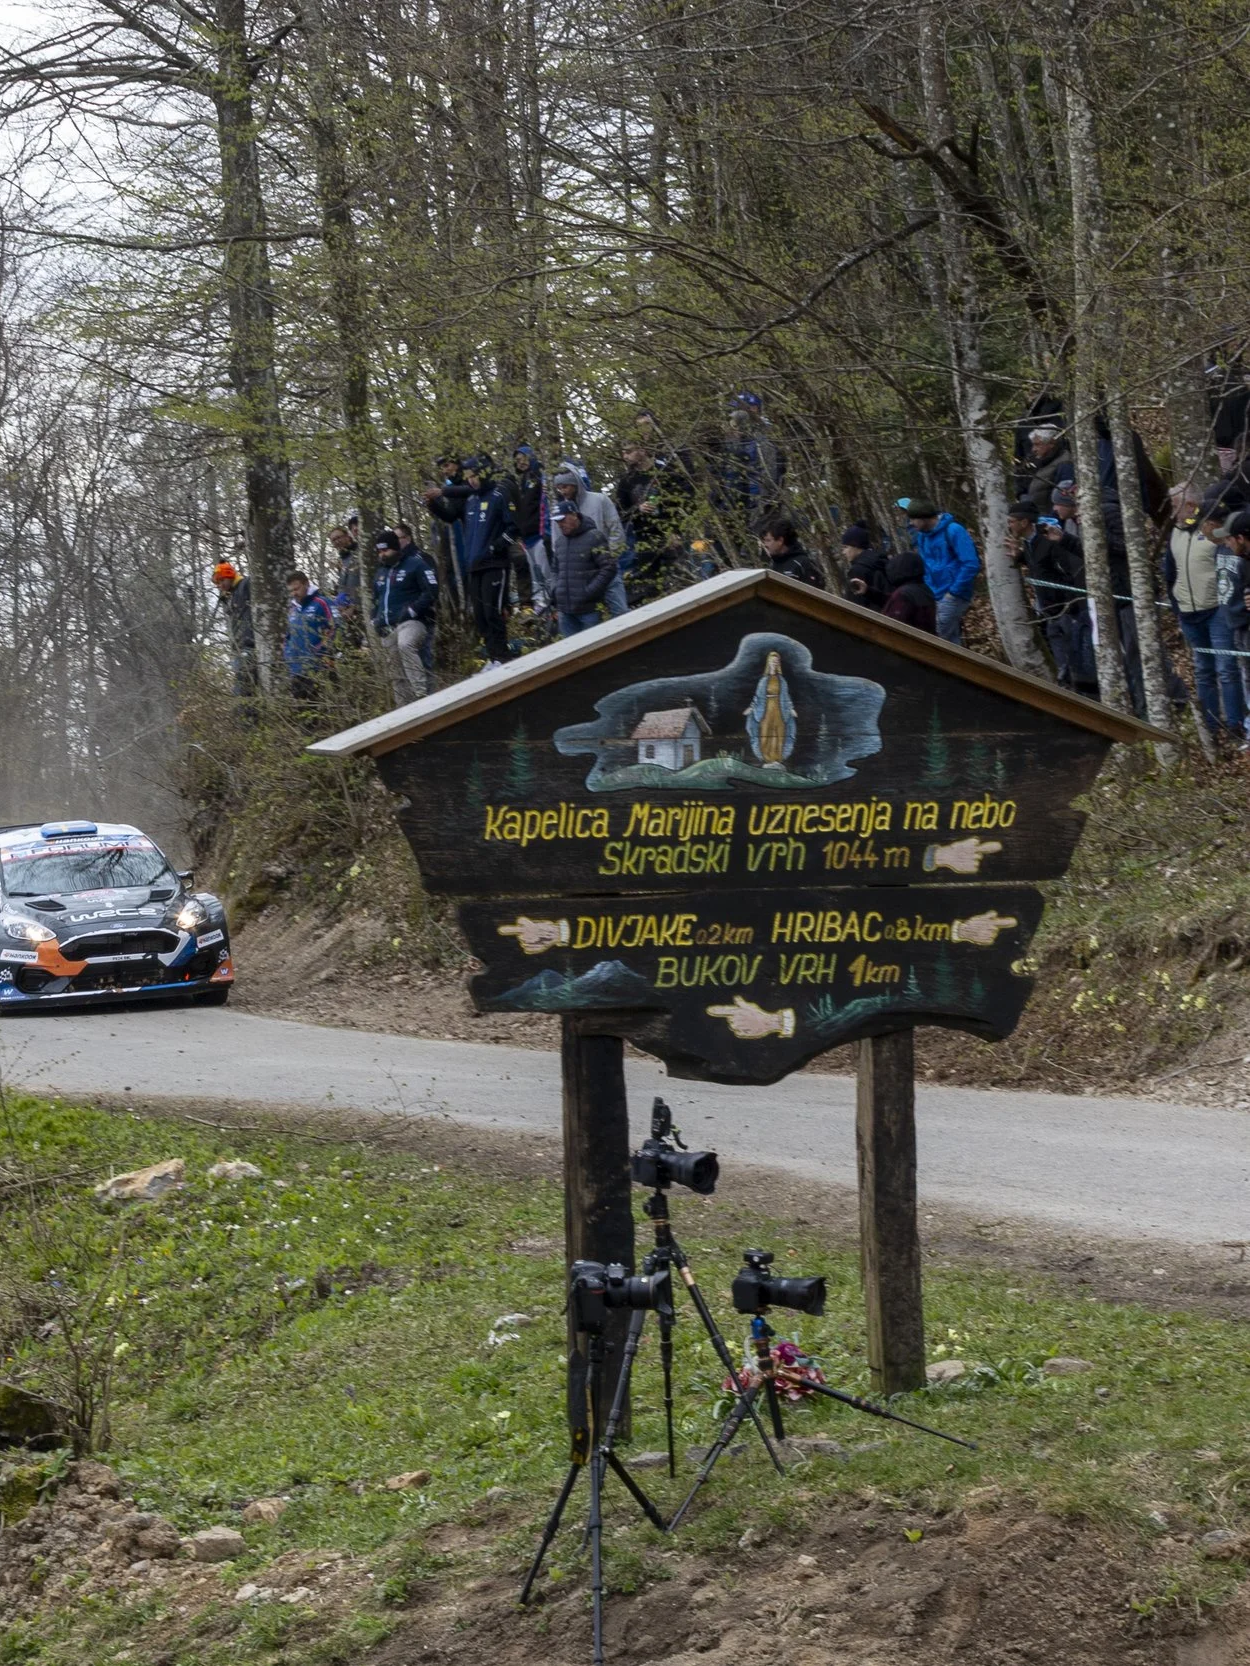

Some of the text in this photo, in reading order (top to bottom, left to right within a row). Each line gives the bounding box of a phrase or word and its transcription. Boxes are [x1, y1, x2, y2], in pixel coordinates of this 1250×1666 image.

[484, 793, 1016, 847] Kapelica Marijina uznesenja na nebo
[598, 837, 910, 875] Skradski vrh 1044 m
[70, 908, 157, 922] WRC2
[572, 914, 698, 949] DIVJAKE
[770, 911, 883, 943] HRIBAC
[654, 953, 763, 988] BUKOV
[780, 953, 838, 985] VRH
